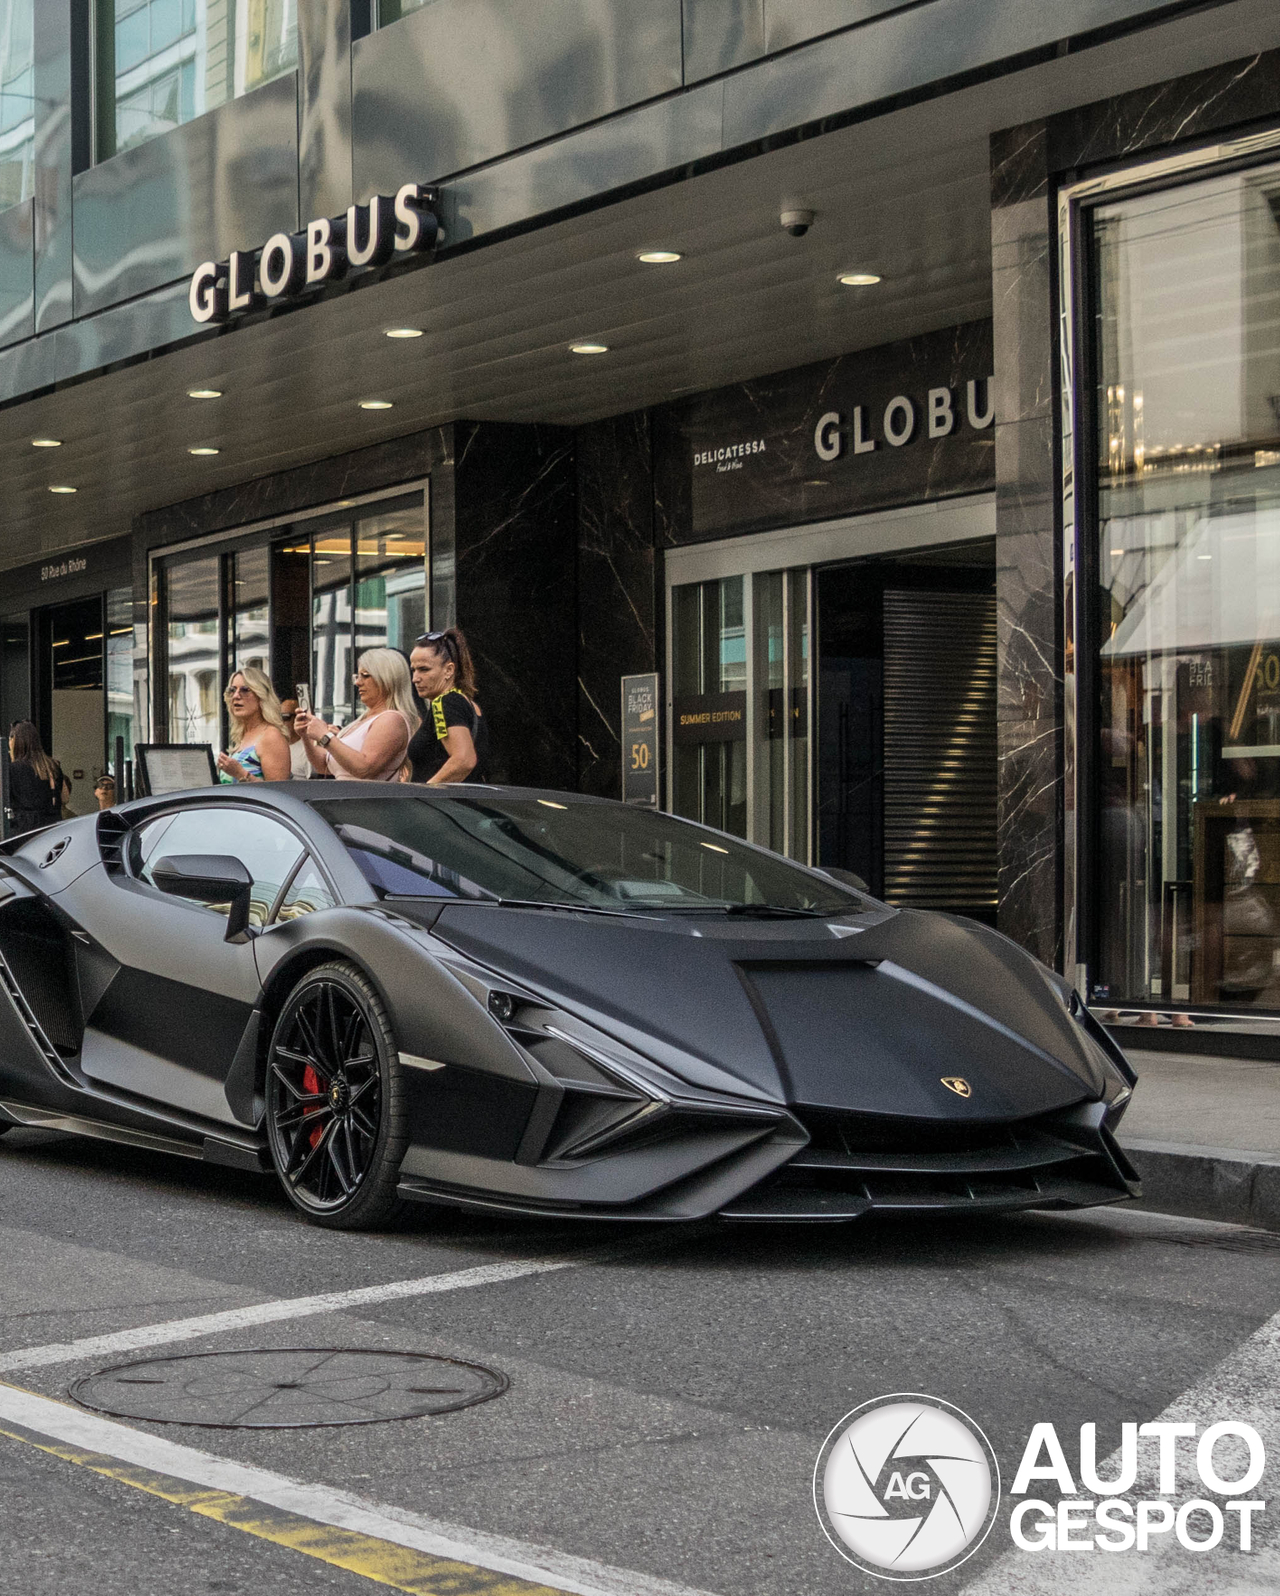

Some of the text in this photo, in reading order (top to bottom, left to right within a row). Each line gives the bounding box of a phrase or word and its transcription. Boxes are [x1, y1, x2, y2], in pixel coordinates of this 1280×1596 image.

[189, 183, 420, 323] GLOBUS
[814, 375, 995, 461] GLOBU
[694, 439, 766, 466] DELICATESSA
[41, 558, 87, 581] 50 Rue du Rhône
[628, 693, 652, 705] BLACK
[628, 702, 652, 714] FRIDAY
[680, 709, 741, 725] SUMMER EDITION
